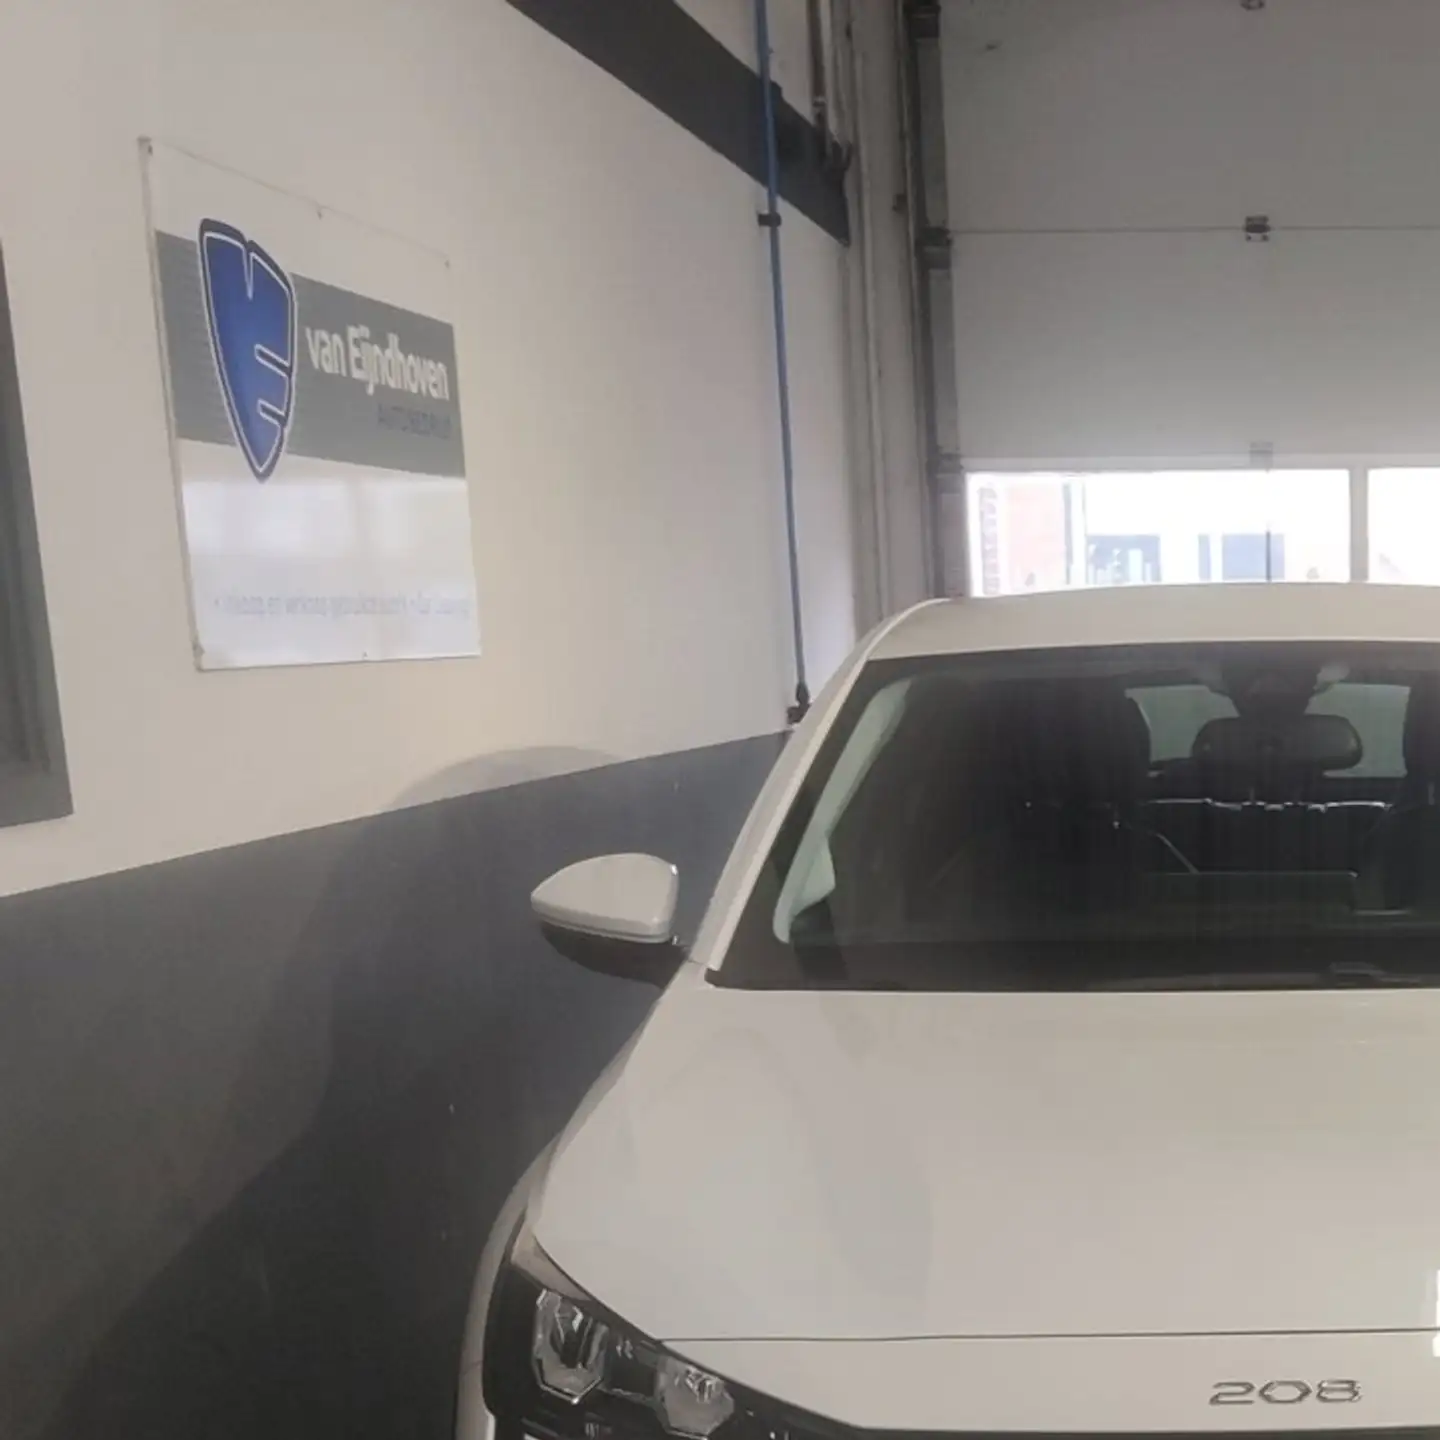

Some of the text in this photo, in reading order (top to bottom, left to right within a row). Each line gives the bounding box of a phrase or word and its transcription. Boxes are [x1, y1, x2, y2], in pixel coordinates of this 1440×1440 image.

[305, 323, 450, 400] van Eijndhoven
[1208, 1379, 1363, 1405] 208
